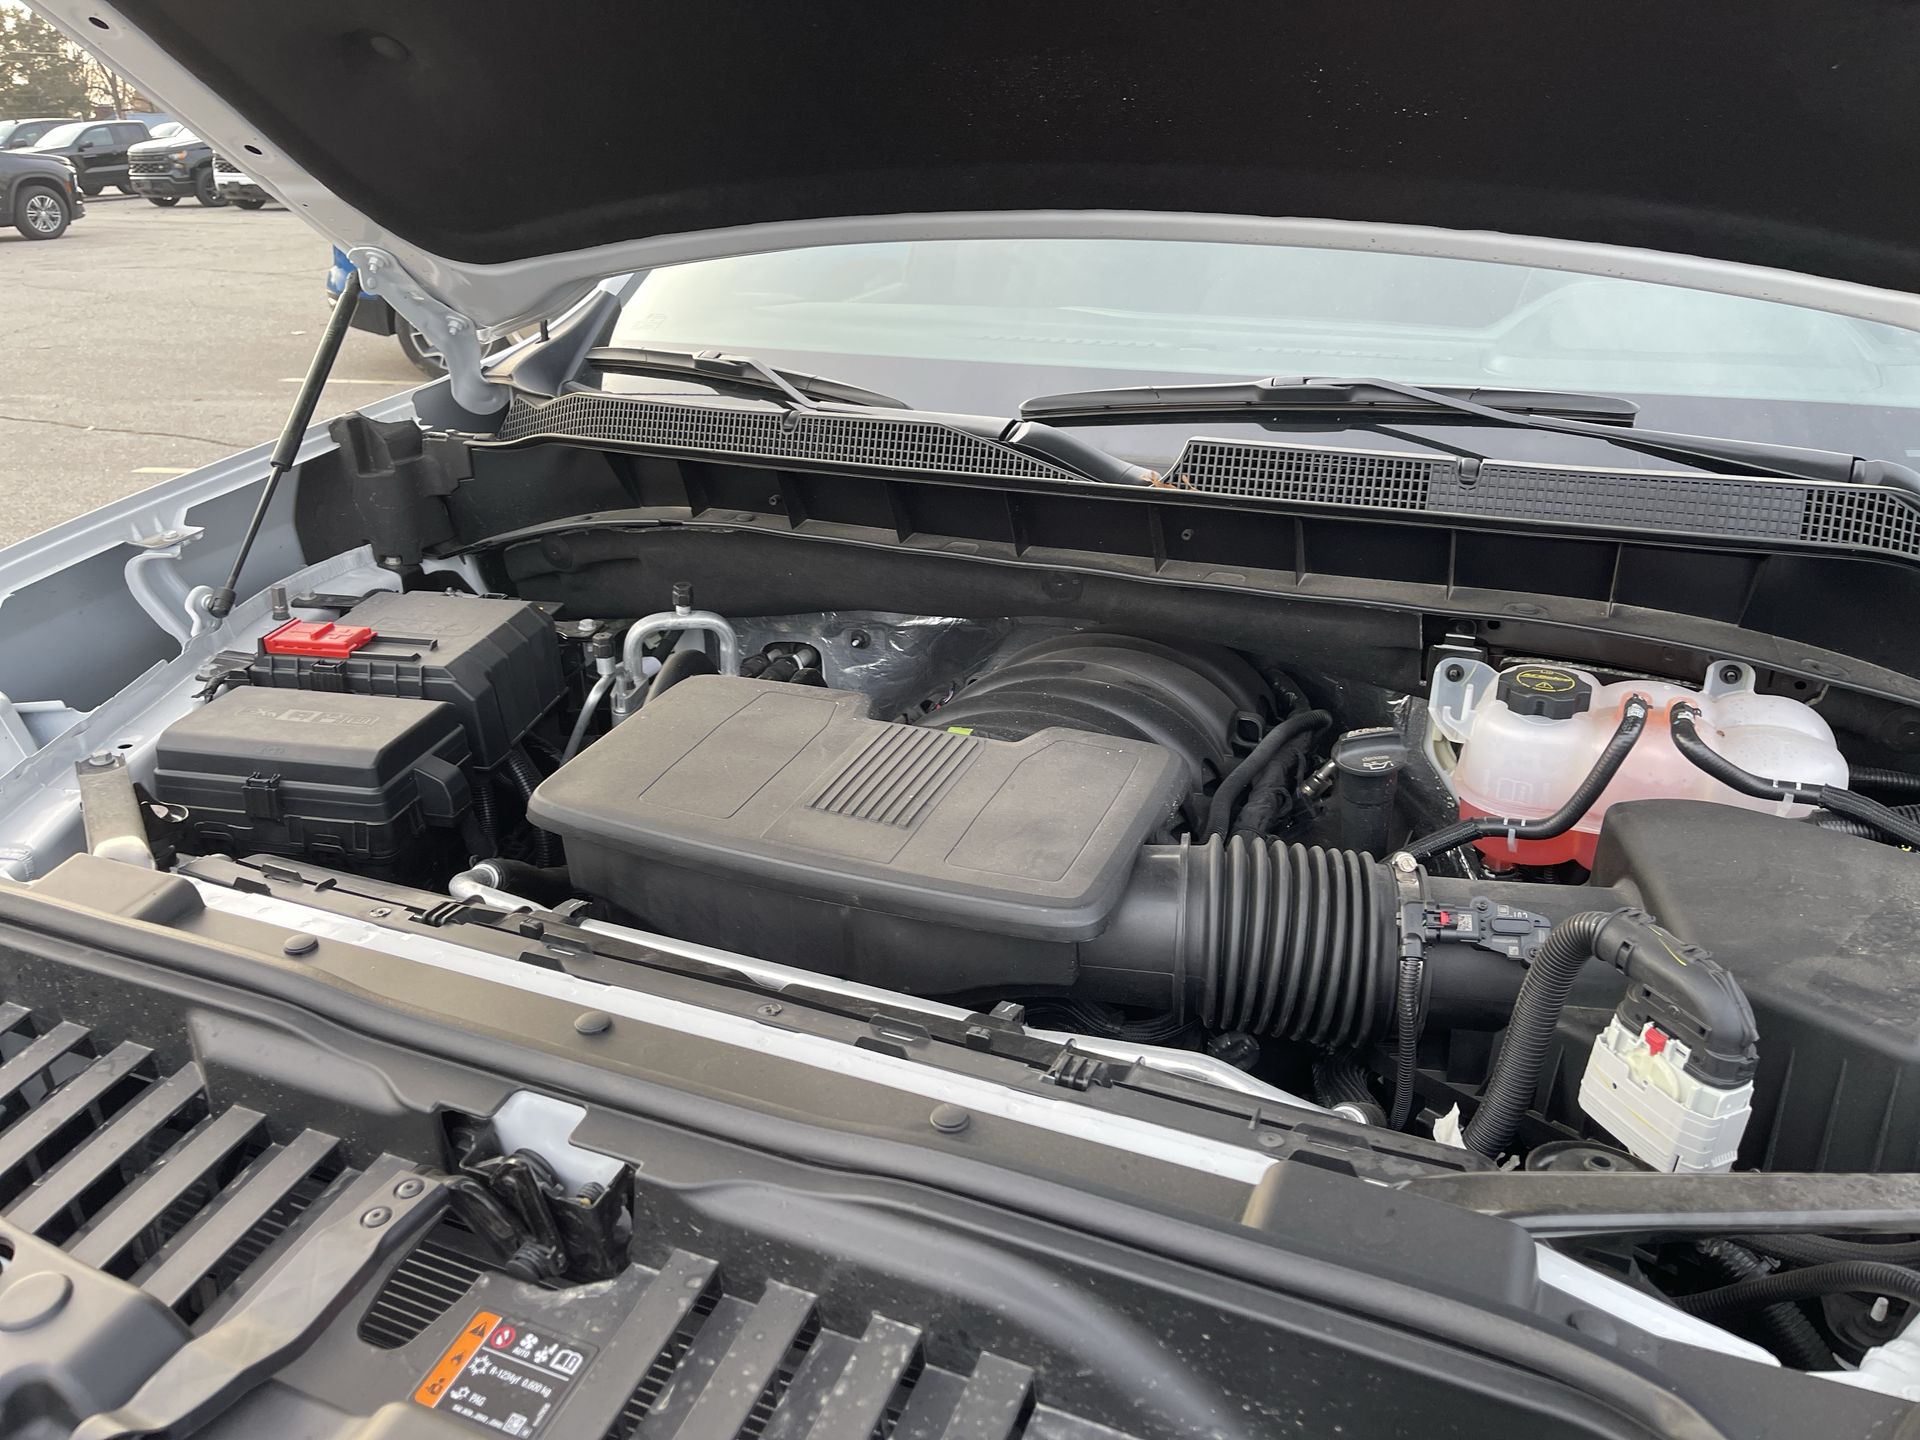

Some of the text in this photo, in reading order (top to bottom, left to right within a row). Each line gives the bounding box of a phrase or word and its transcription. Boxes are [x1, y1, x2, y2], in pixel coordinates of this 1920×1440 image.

[1346, 726, 1394, 738] ACDelco
[512, 1346, 531, 1359] AUTO
[489, 1366, 522, 1385] R-1234yf
[540, 1386, 552, 1398] kg
[468, 1392, 487, 1407] PAG
